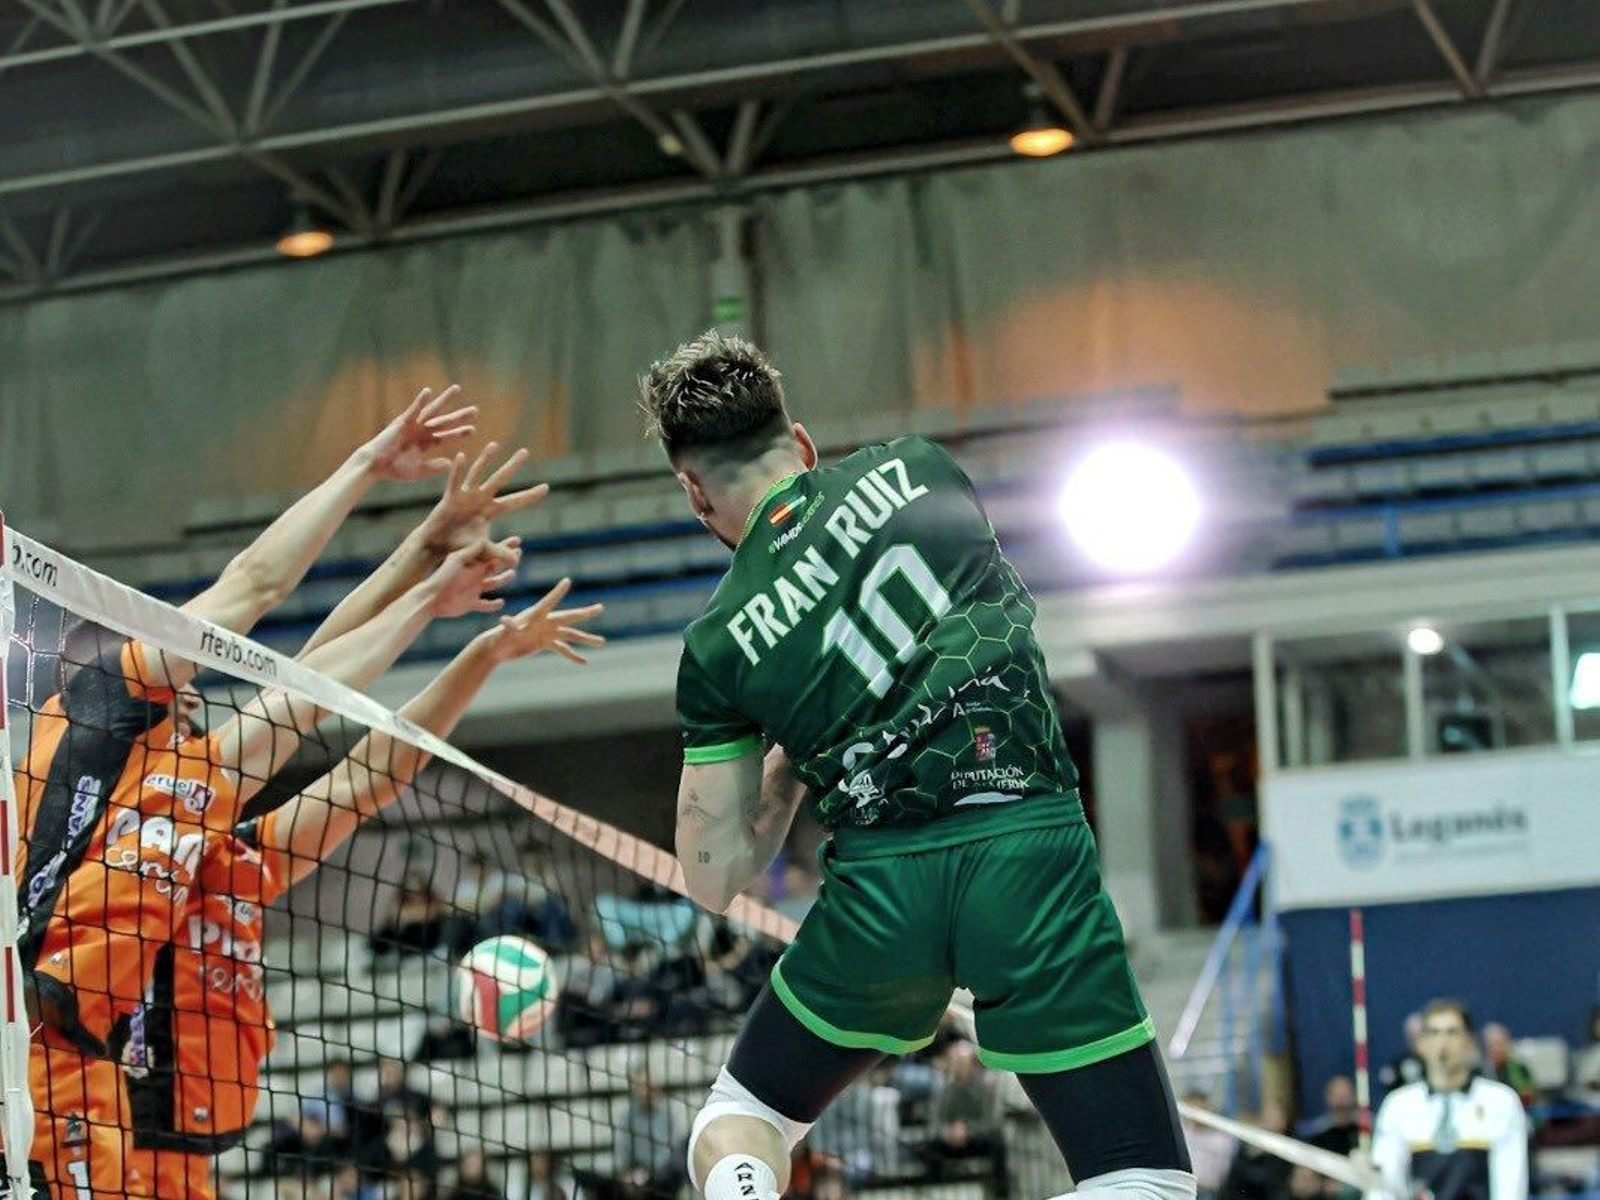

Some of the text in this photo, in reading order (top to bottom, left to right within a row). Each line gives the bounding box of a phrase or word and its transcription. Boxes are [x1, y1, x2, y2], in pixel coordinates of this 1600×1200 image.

[726, 458, 930, 667] FRAN RUIZ
[200, 629, 278, 678] rfevb.com
[822, 543, 953, 700] 10
[696, 851, 710, 864] 10
